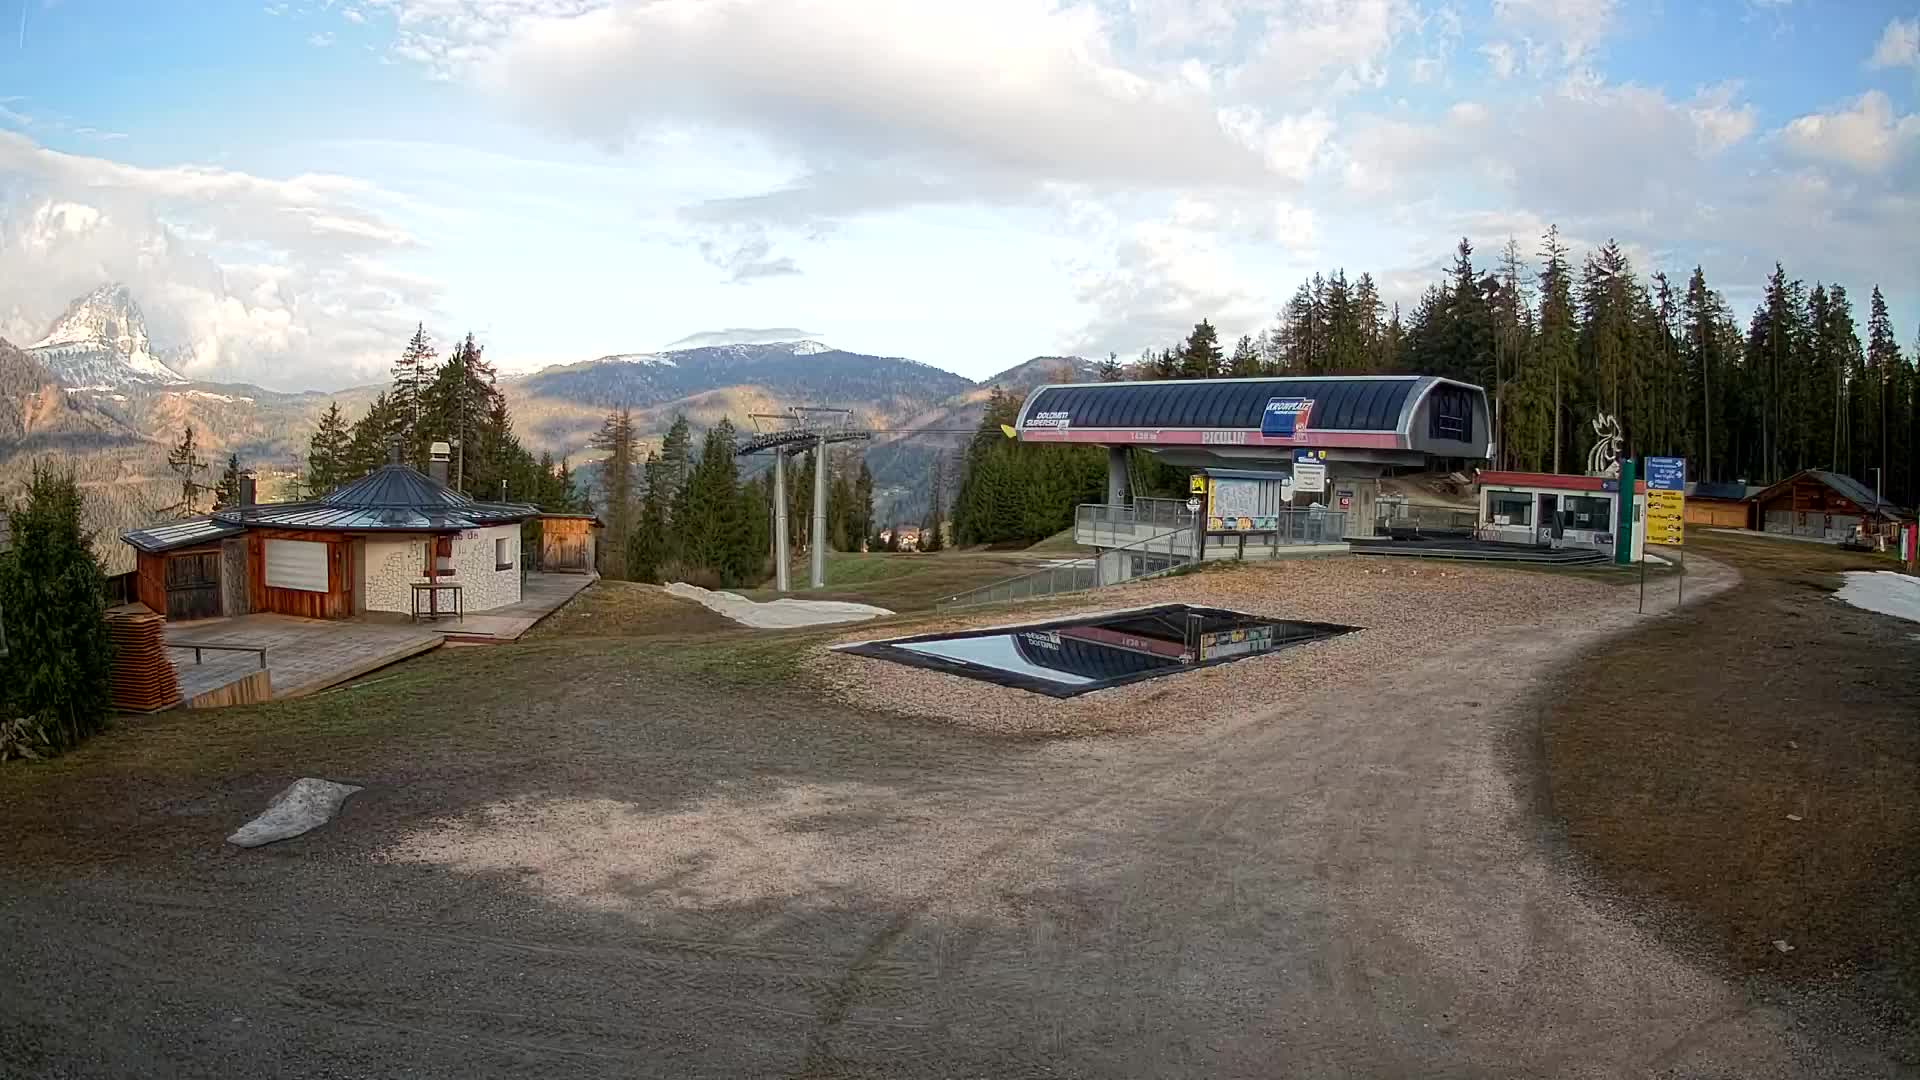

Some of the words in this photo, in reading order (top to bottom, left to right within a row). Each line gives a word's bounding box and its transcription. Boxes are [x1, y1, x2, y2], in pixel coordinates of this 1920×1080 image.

[1036, 411, 1069, 419] DOLOMITI
[1026, 419, 1058, 427] SUPERSKI
[1201, 431, 1246, 445] PICULIN
